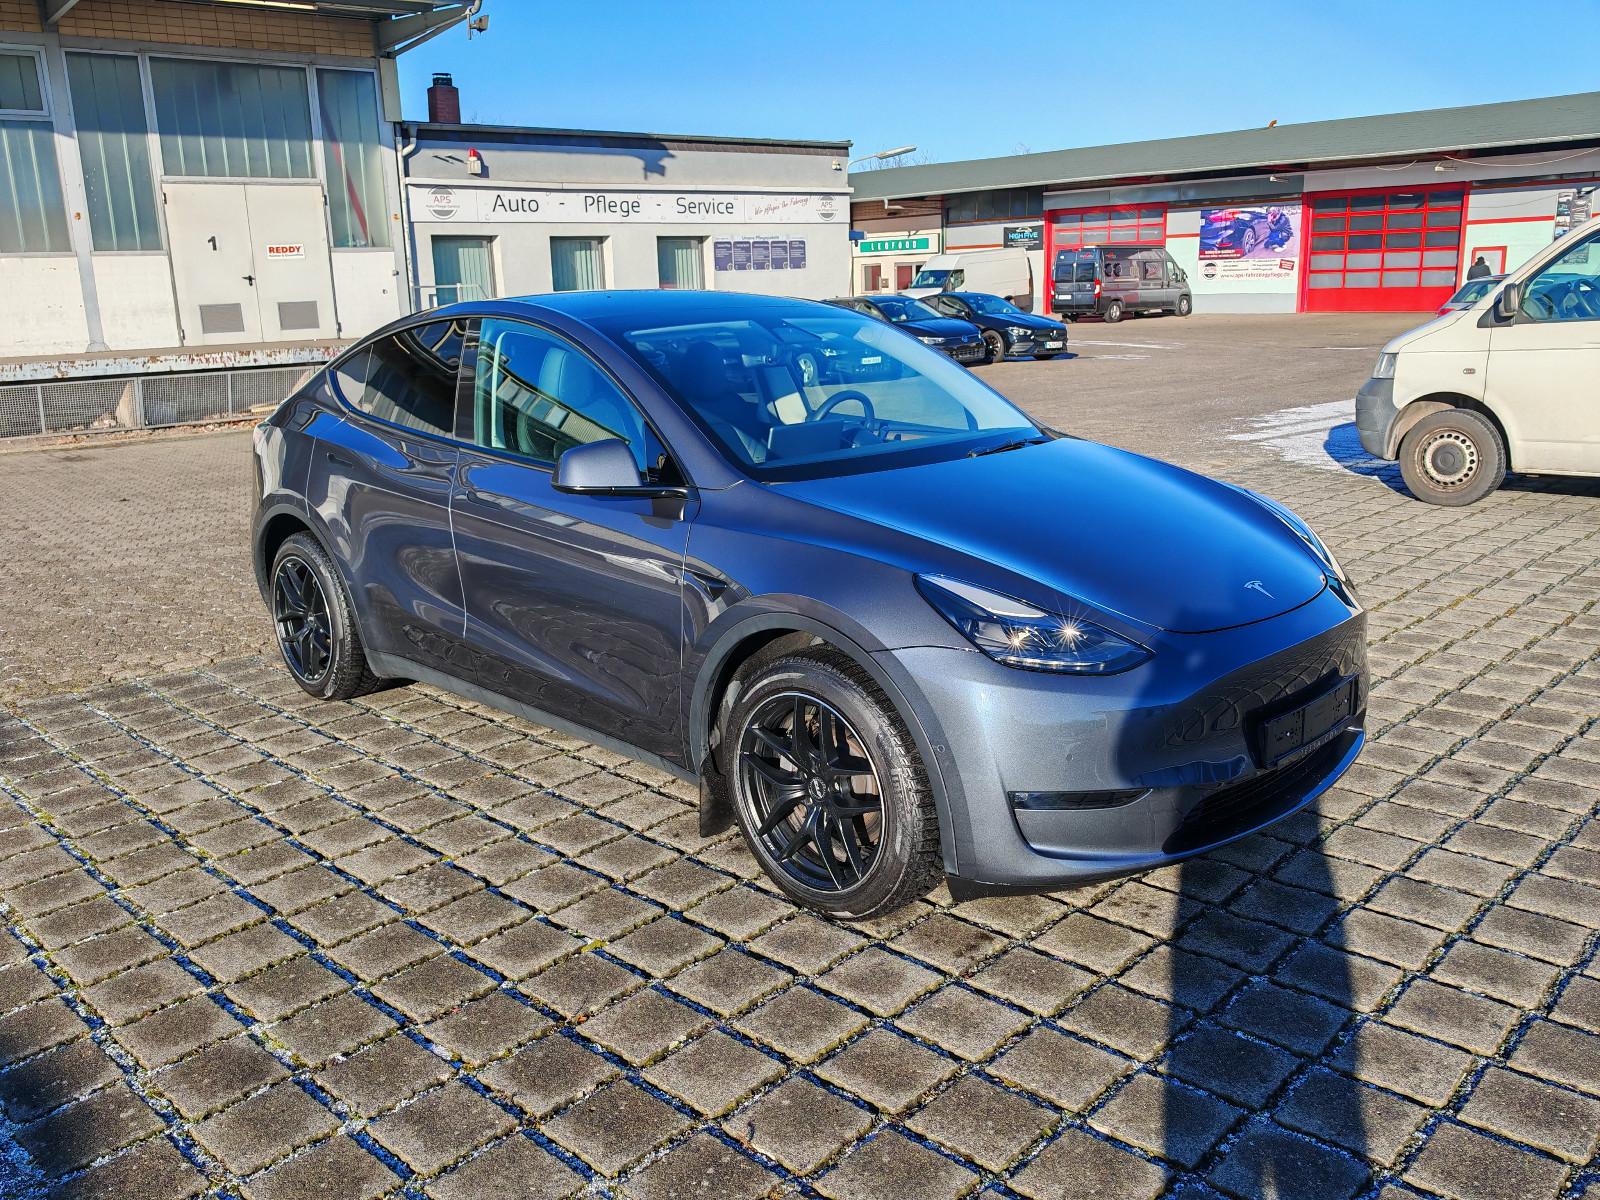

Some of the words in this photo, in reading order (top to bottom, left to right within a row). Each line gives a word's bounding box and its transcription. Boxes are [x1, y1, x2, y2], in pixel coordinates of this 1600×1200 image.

[433, 195, 452, 204] APS
[492, 194, 540, 213] Auto
[584, 195, 641, 218] Pflege
[676, 196, 735, 215] Service
[820, 201, 833, 209] APS
[1008, 232, 1024, 240] HIGH
[1024, 231, 1039, 239] FIVE
[207, 236, 217, 251] 1
[268, 245, 301, 253] REDDY
